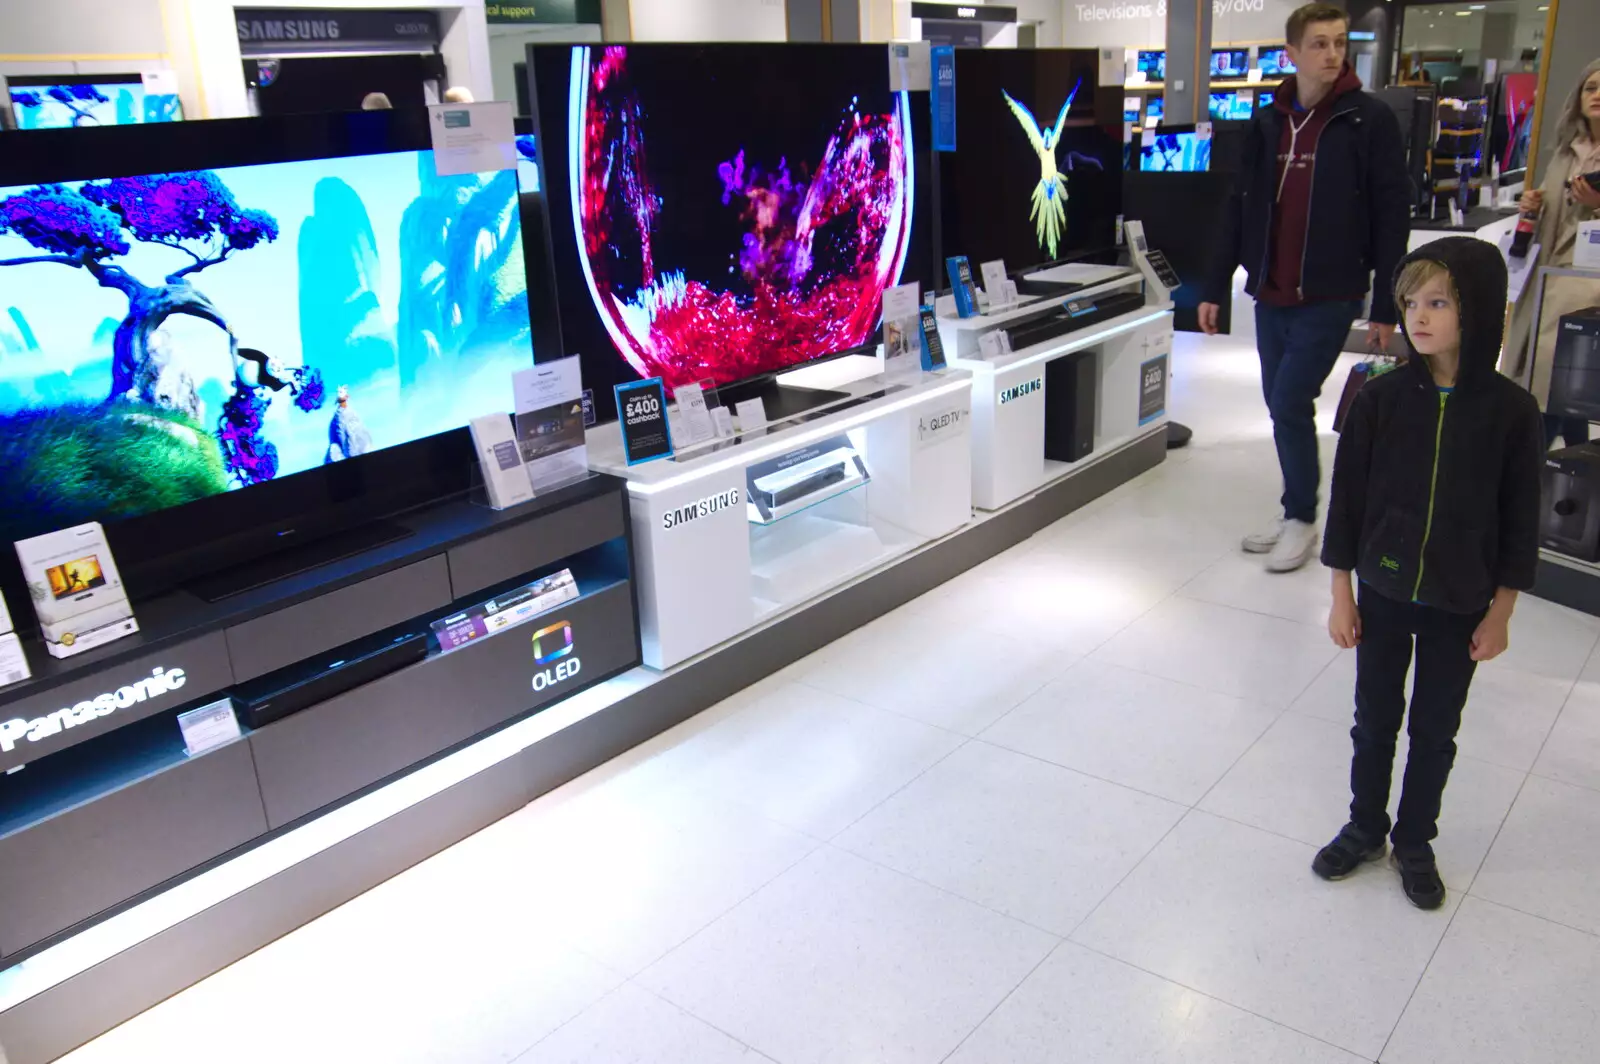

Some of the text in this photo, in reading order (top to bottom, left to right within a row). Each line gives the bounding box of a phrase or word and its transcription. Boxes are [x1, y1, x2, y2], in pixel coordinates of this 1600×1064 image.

[501, 6, 536, 19] support
[1075, 4, 1152, 22] Televisions
[238, 19, 340, 39] SAMSUNG
[1001, 378, 1042, 404] SAMSUNG
[626, 398, 659, 417] £400
[627, 411, 660, 425] cashback
[930, 414, 950, 431] QLED
[951, 410, 960, 421] TV
[663, 488, 739, 529] SAMSUNG
[532, 657, 580, 692] OLED
[0, 667, 186, 752] Panasonic
